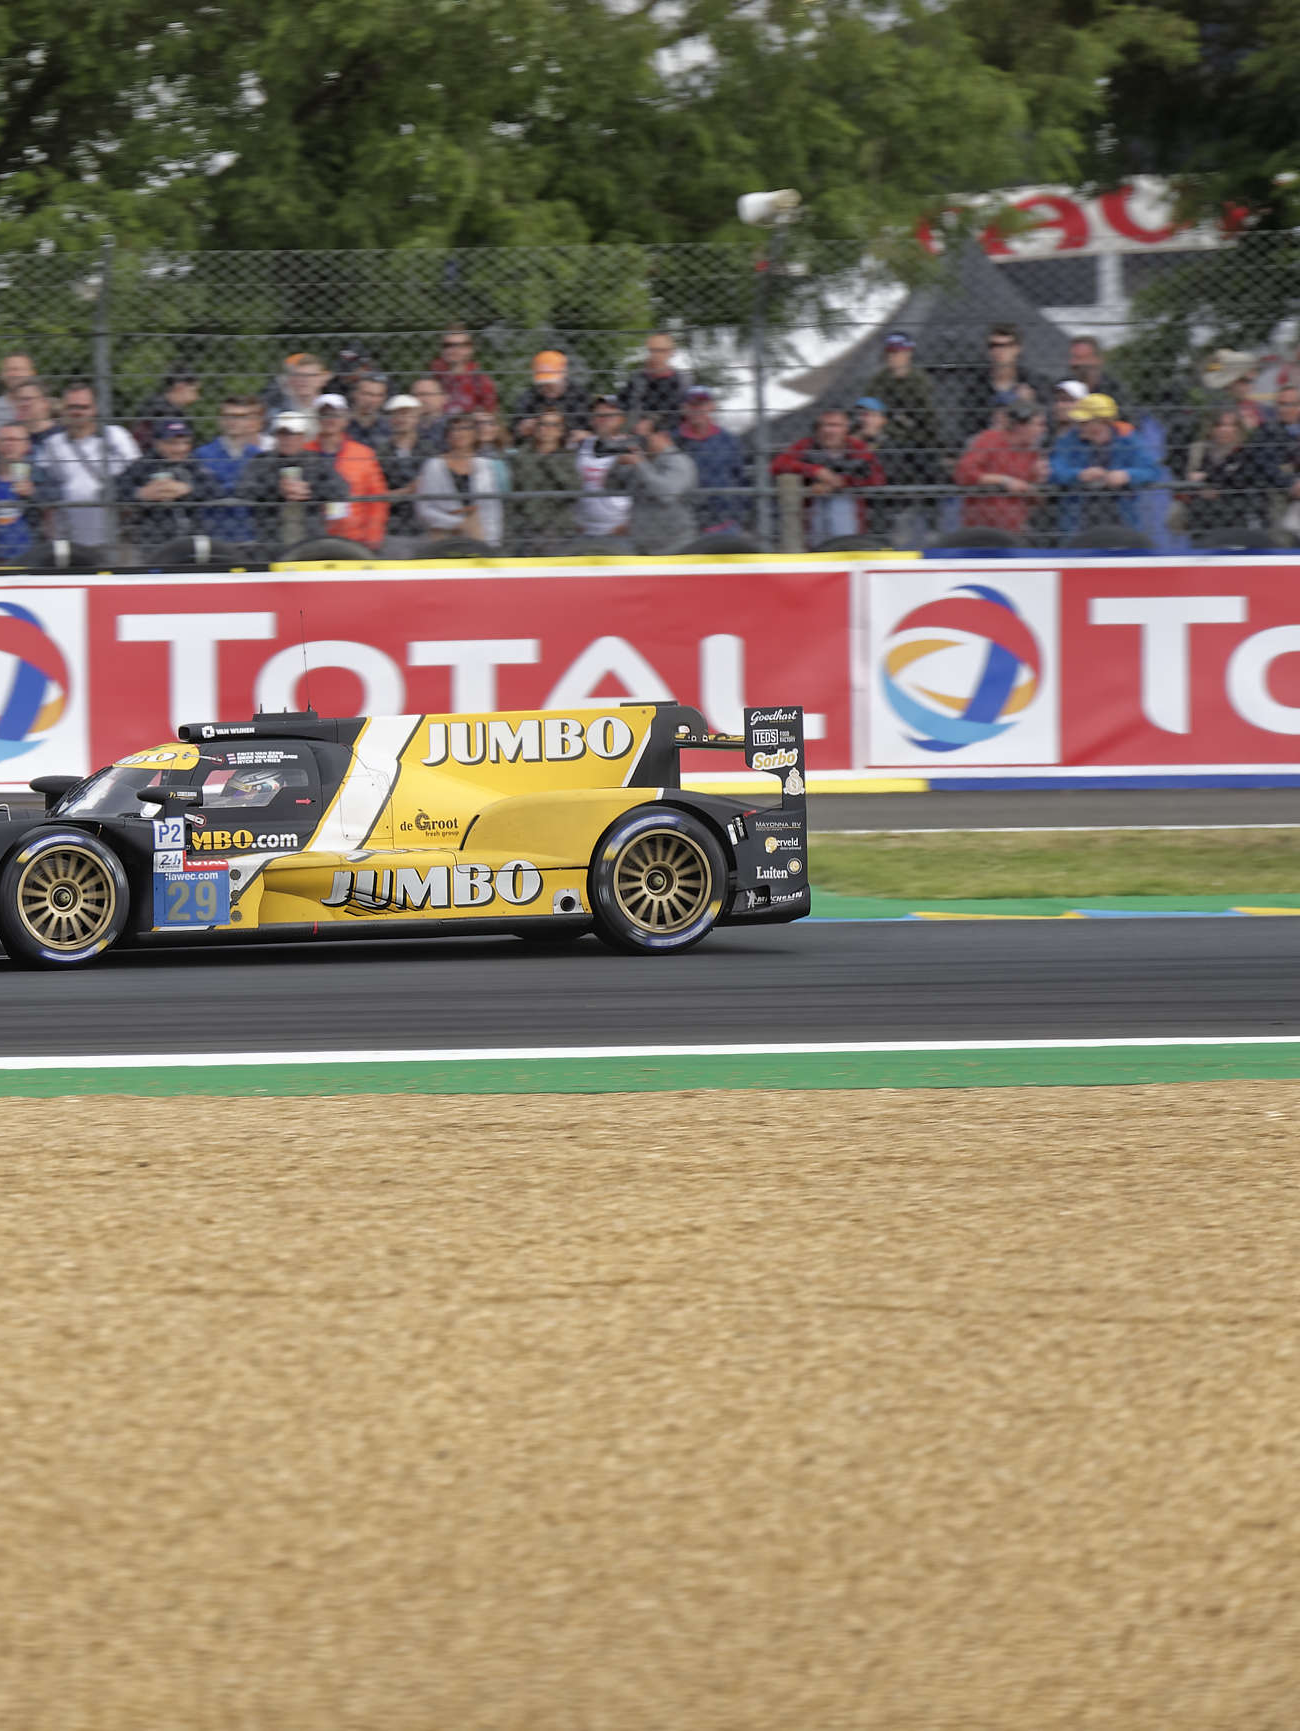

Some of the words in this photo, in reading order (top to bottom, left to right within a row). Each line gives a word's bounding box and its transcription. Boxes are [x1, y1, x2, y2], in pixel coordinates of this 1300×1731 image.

[750, 709, 797, 726] Goodhart
[420, 716, 634, 766] JUMBO
[754, 750, 796, 769] Sorbo
[400, 821, 413, 831] de
[415, 810, 459, 831] Groot
[158, 824, 181, 843] P2
[756, 867, 788, 879] Luiten
[320, 860, 543, 909] JUMBO
[167, 880, 217, 921] 29
